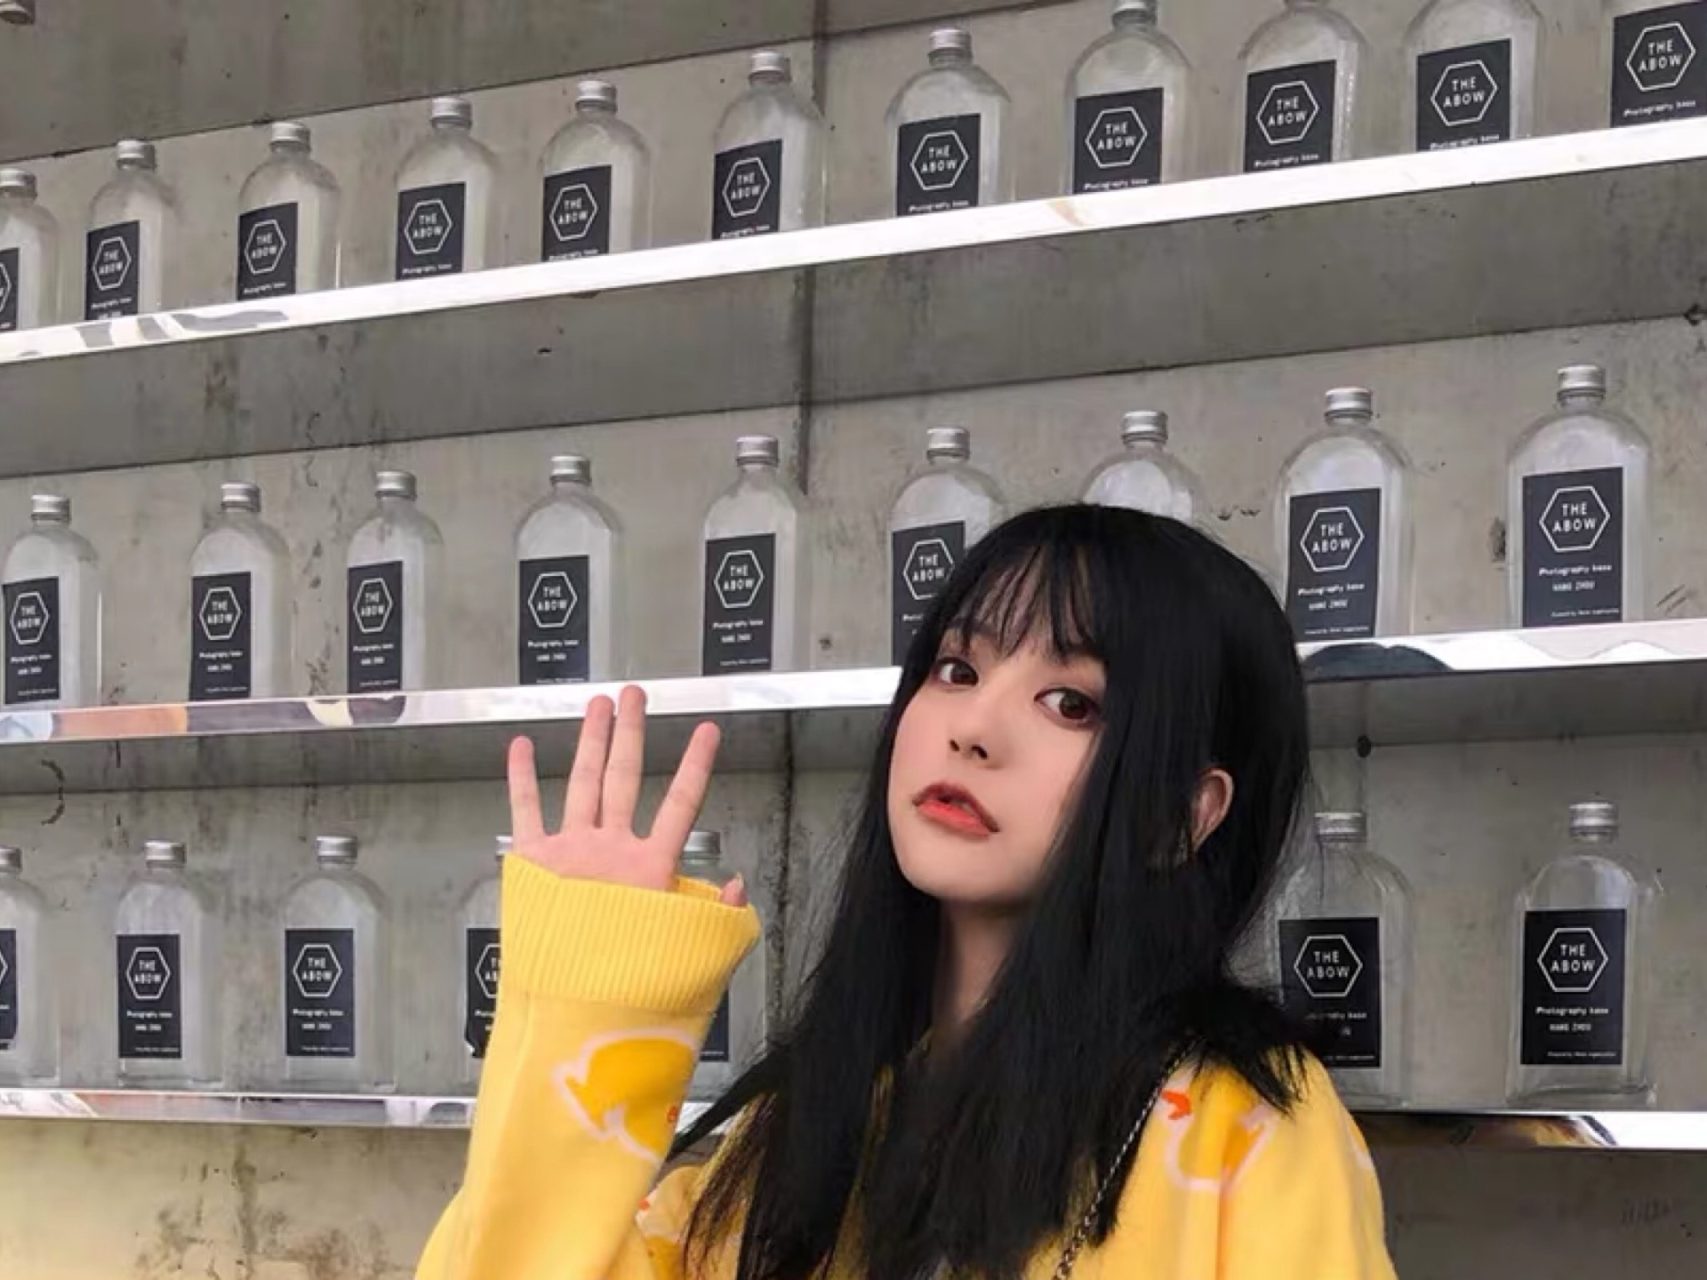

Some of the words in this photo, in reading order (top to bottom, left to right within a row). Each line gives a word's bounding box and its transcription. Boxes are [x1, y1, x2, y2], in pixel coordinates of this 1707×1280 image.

[1649, 39, 1674, 55] THE
[1639, 54, 1683, 72] ABOW
[1451, 76, 1476, 92] THE
[1276, 95, 1300, 110] THE
[1443, 91, 1485, 108] ABOW
[1105, 121, 1128, 135] THE
[929, 144, 950, 158] THE
[1562, 502, 1587, 517] THE
[1320, 522, 1344, 537] THE
[1552, 518, 1597, 532] ABOW
[1311, 538, 1353, 553] ABOW
[1314, 951, 1340, 963] THE
[1560, 944, 1586, 957] THE
[1306, 965, 1350, 979] ABOW
[1551, 959, 1596, 973] ABOW
